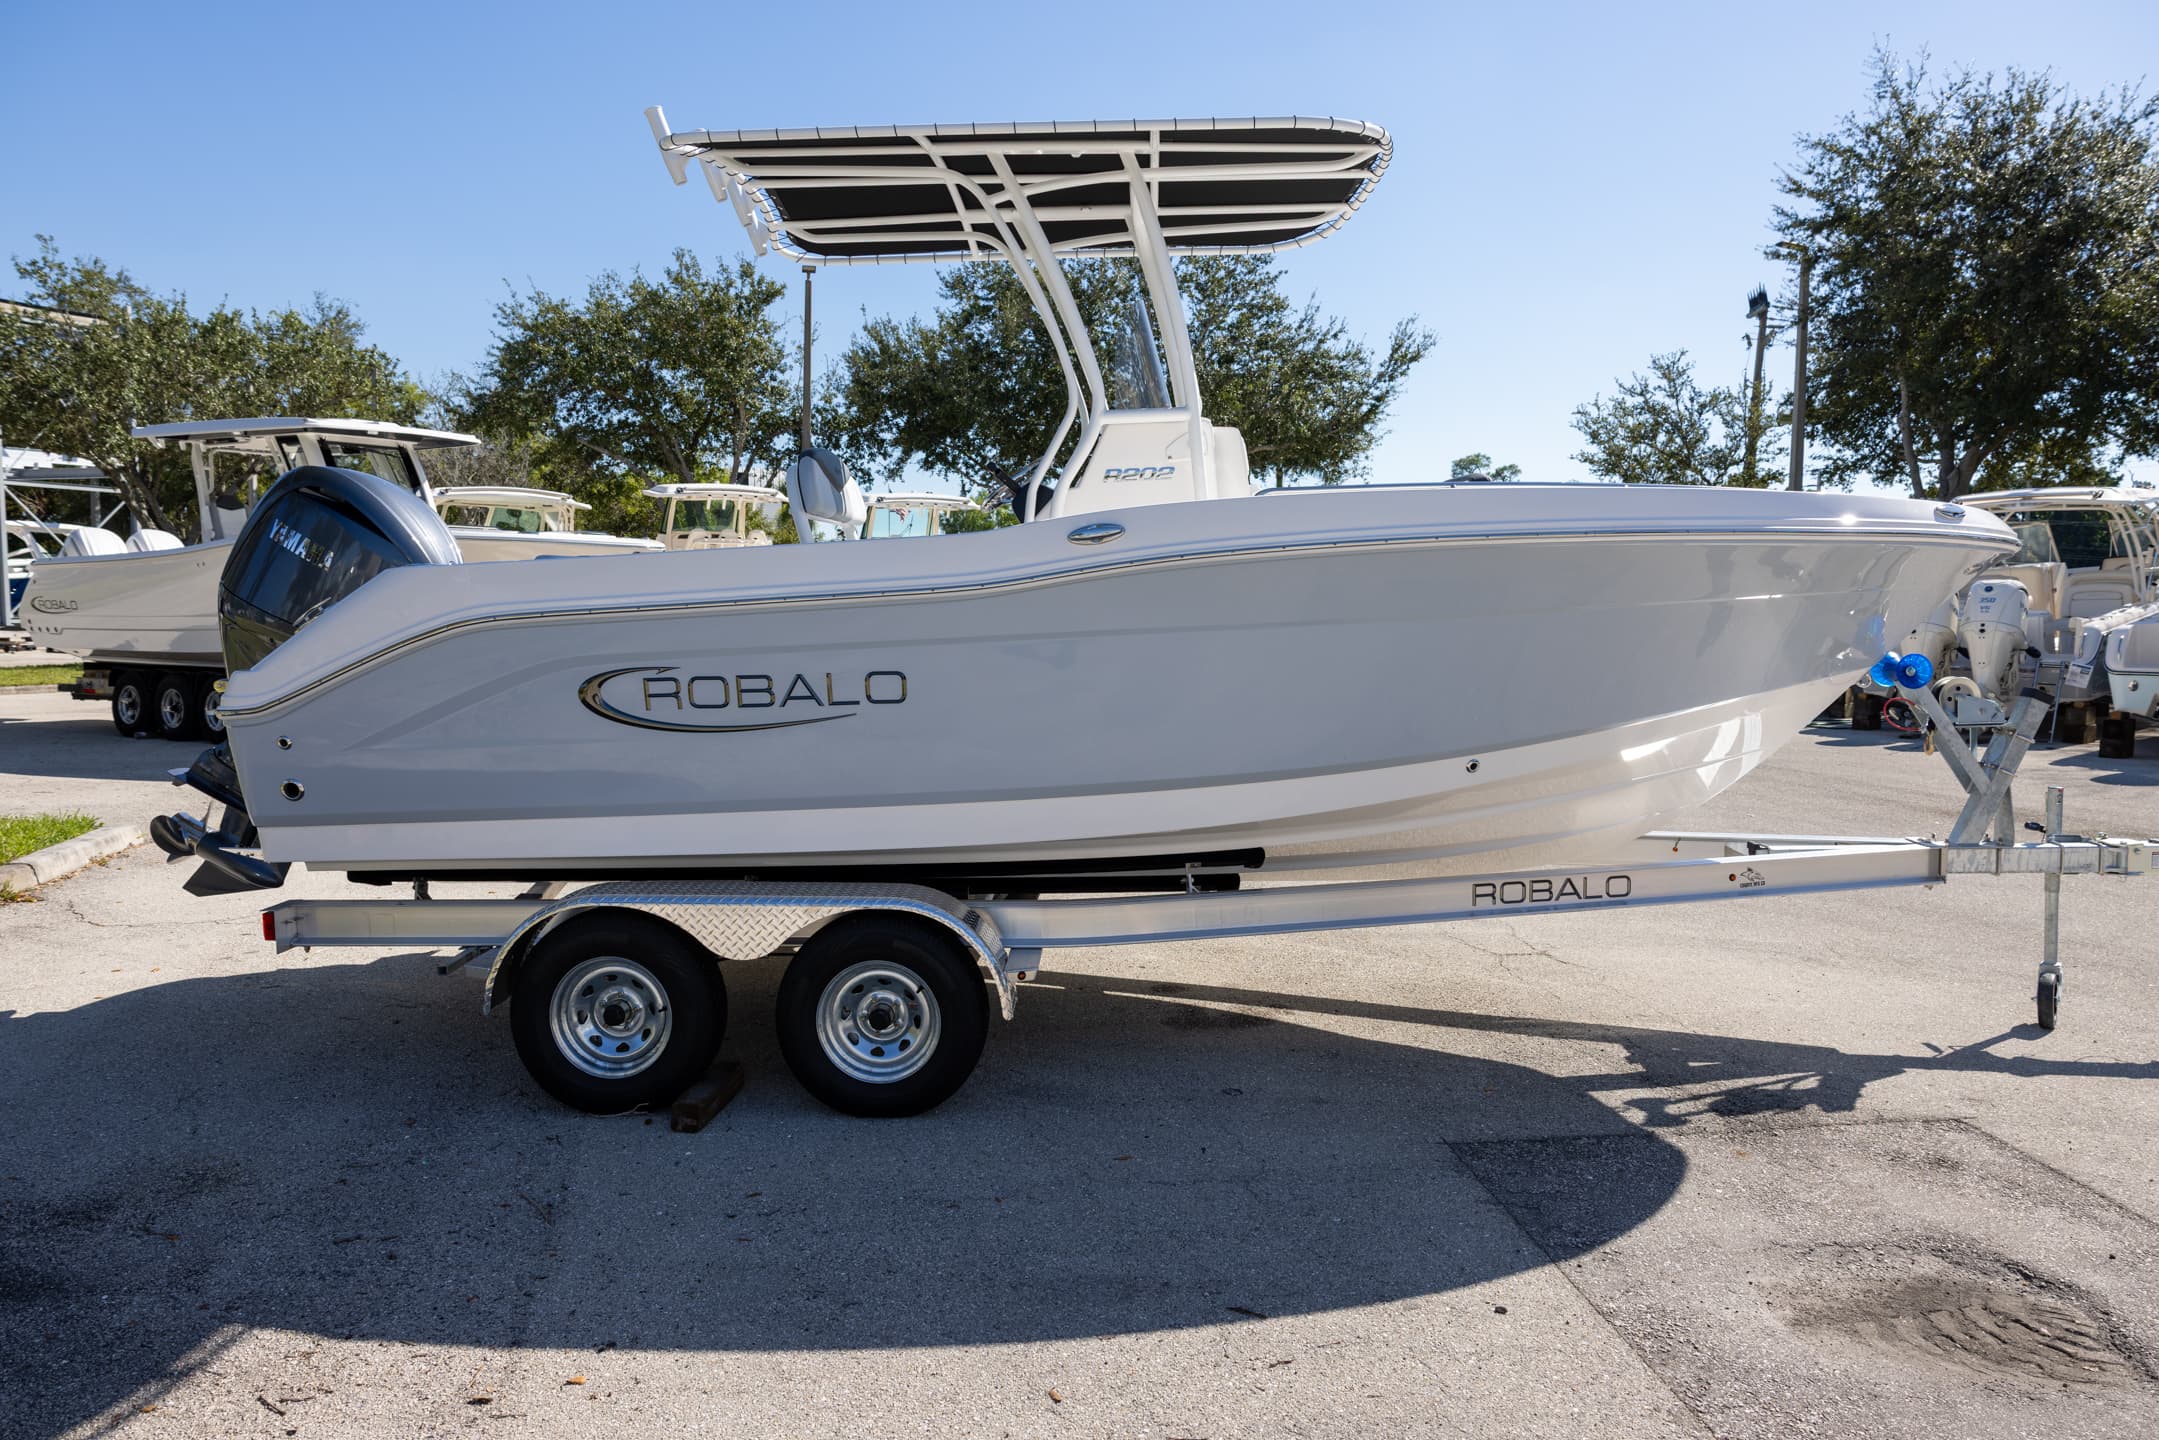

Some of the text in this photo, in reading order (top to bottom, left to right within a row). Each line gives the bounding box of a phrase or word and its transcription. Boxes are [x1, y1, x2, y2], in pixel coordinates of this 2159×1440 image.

[1103, 466, 1175, 483] R202
[269, 518, 334, 572] YAMAHA
[38, 599, 79, 611] ROBALO
[642, 670, 907, 711] ROBALO
[1472, 875, 1632, 907] ROBALO
